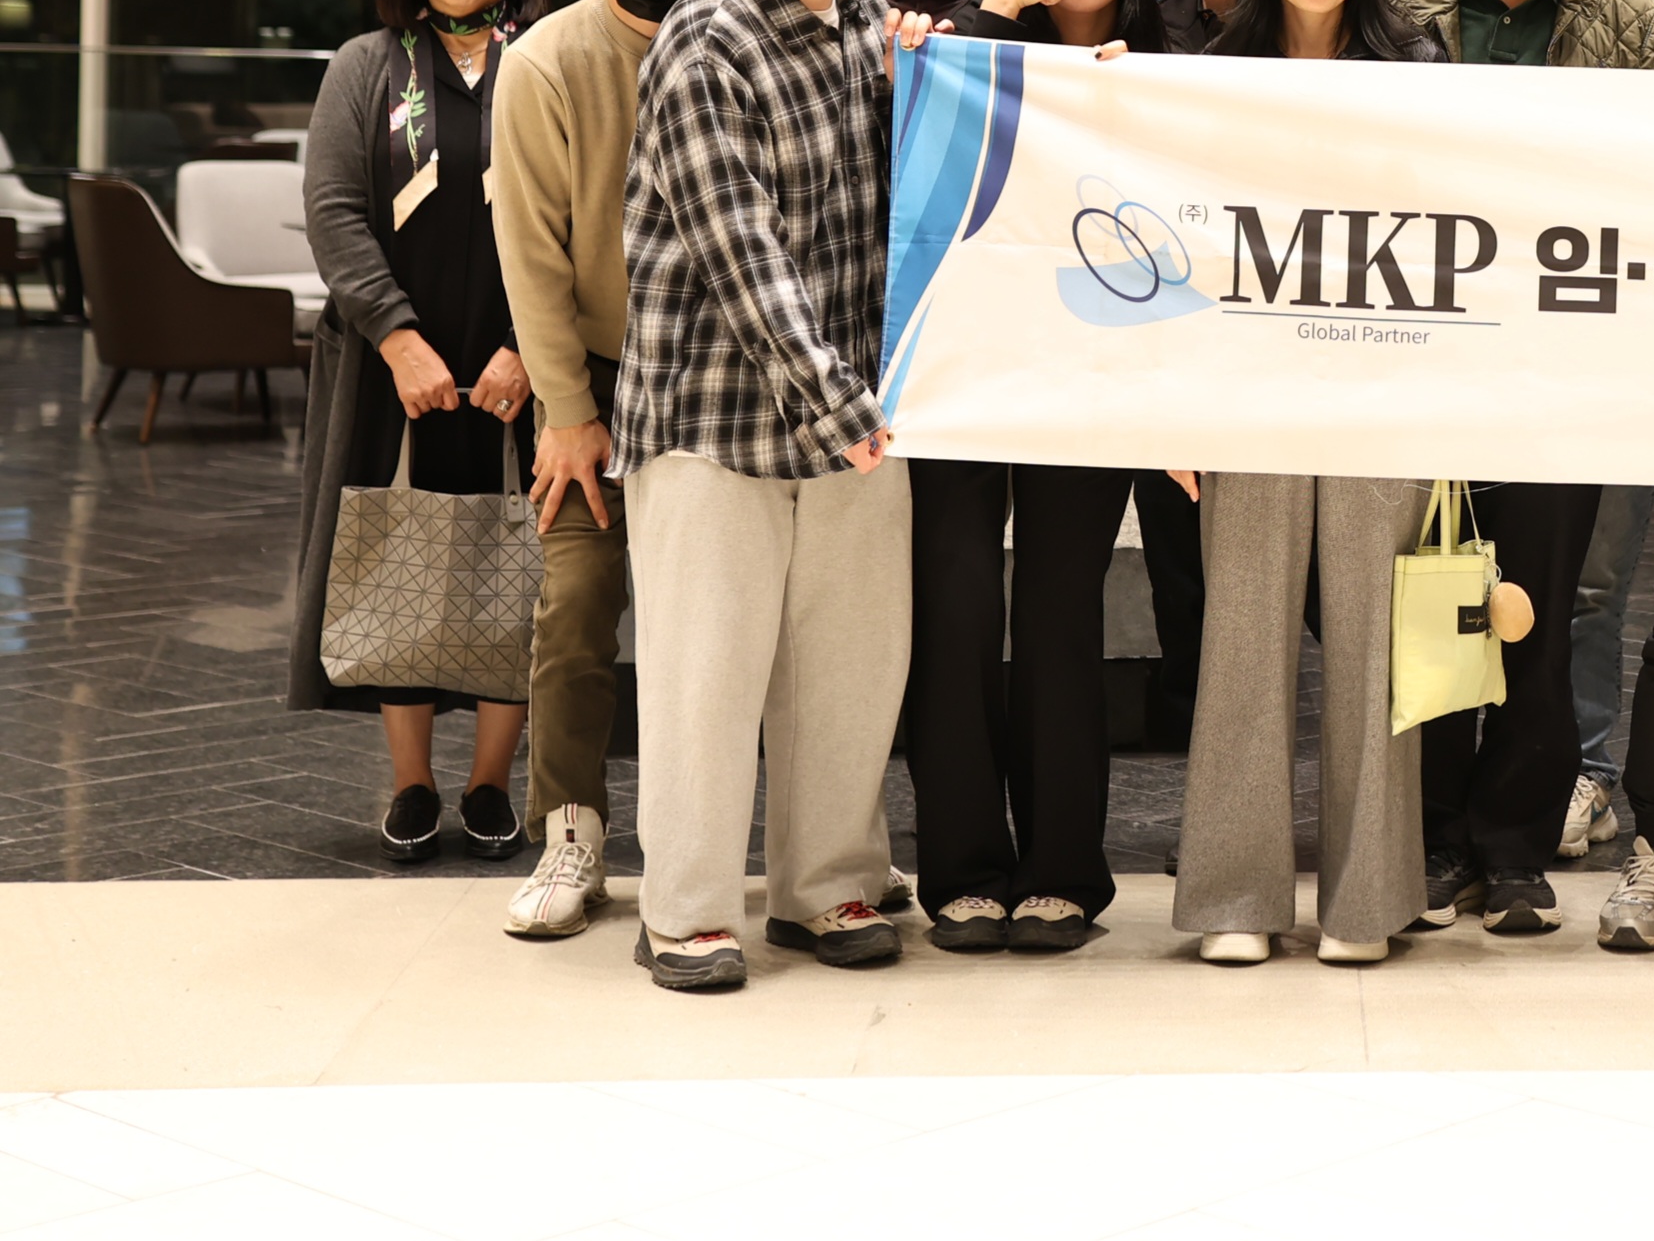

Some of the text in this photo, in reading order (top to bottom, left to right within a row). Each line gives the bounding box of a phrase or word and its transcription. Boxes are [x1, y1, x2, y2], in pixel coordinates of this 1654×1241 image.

[1178, 203, 1209, 225] (주)
[1219, 205, 1498, 313] MKP
[1297, 322, 1431, 345] Global Partner
